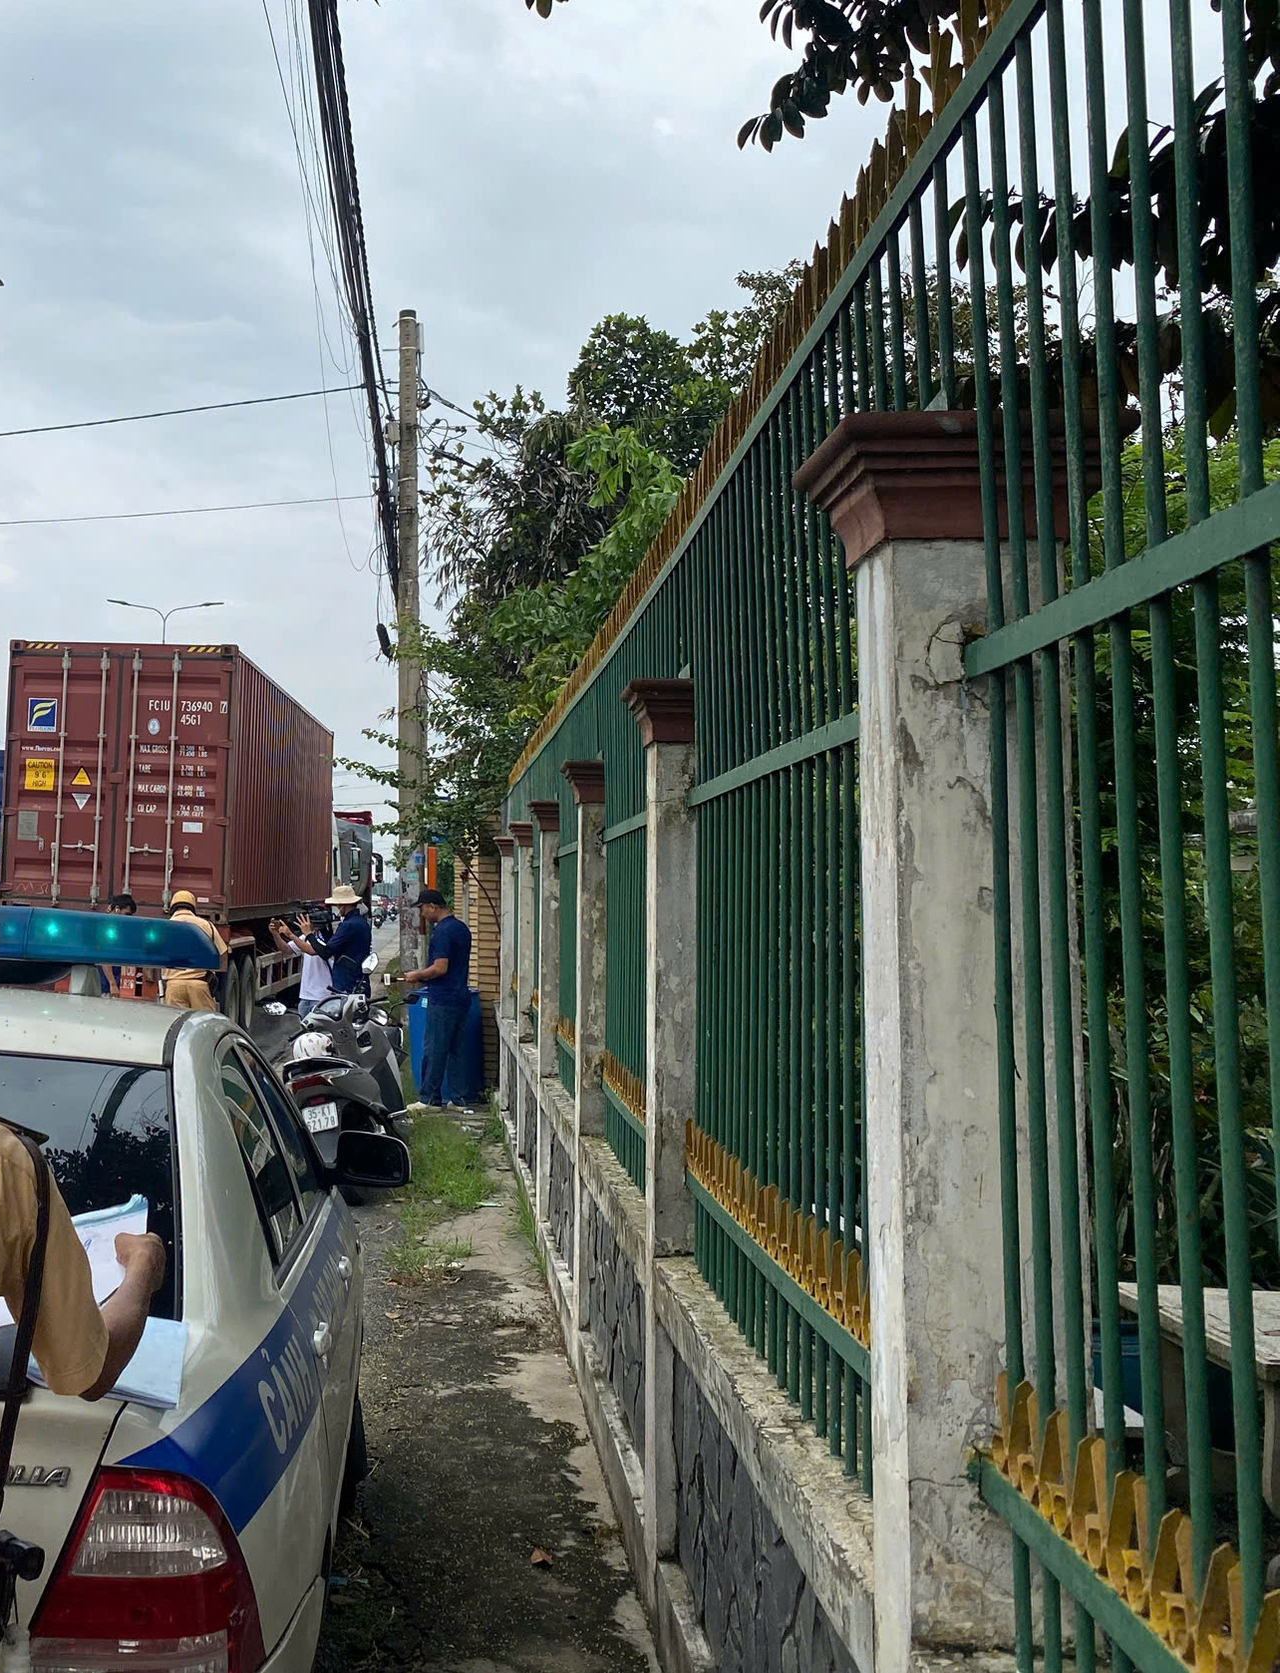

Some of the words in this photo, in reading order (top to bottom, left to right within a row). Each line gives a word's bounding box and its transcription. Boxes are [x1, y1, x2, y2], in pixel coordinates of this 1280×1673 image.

[148, 700, 171, 711] FCIU
[180, 701, 213, 712] 736940
[180, 714, 201, 725] 45G1
[27, 761, 52, 769] CAUTION
